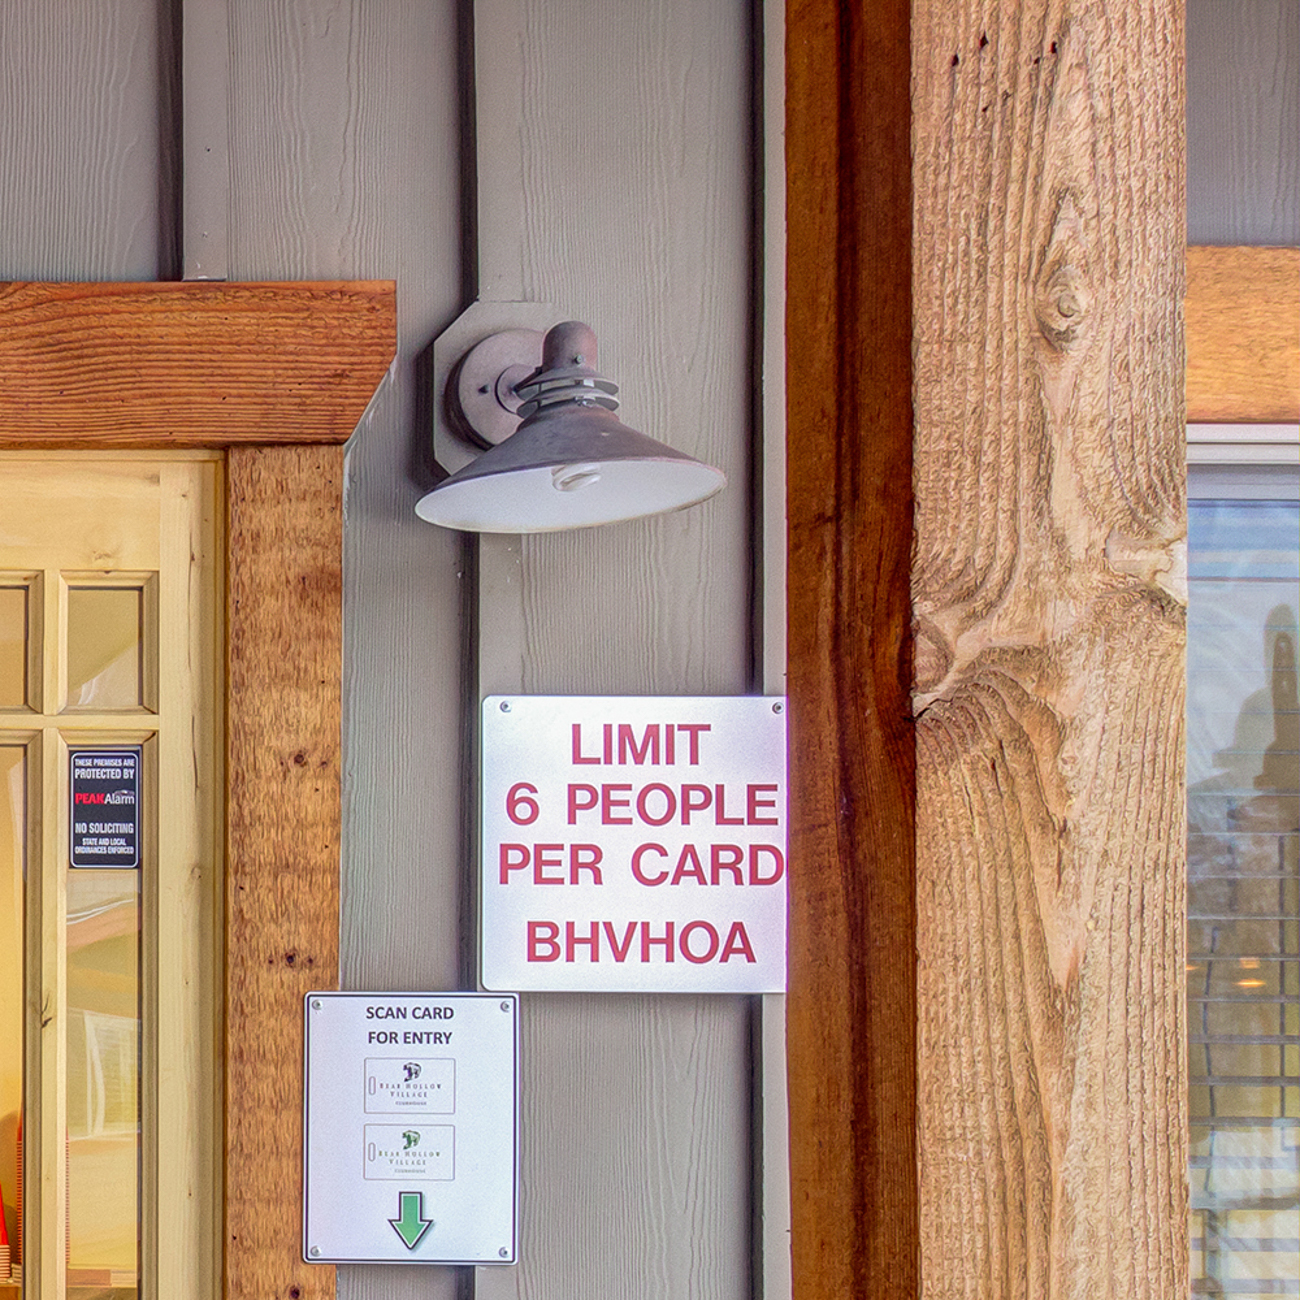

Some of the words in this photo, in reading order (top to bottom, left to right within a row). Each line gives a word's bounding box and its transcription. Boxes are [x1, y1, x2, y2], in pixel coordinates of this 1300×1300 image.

[572, 723, 711, 765] LIMIT
[75, 768, 121, 779] PROTECTED
[123, 768, 134, 779] BY
[506, 782, 540, 825] 6
[567, 783, 779, 826] PEOPLE
[75, 823, 87, 833] NO
[89, 823, 134, 833] SOLICITING
[499, 843, 603, 885] PER
[631, 843, 784, 886] CARD
[527, 921, 756, 964] BHVHOA
[366, 1006, 407, 1019] SCAN
[412, 1007, 454, 1019] CARD
[368, 1032, 399, 1044] FOR
[403, 1032, 452, 1044] ENTRY
